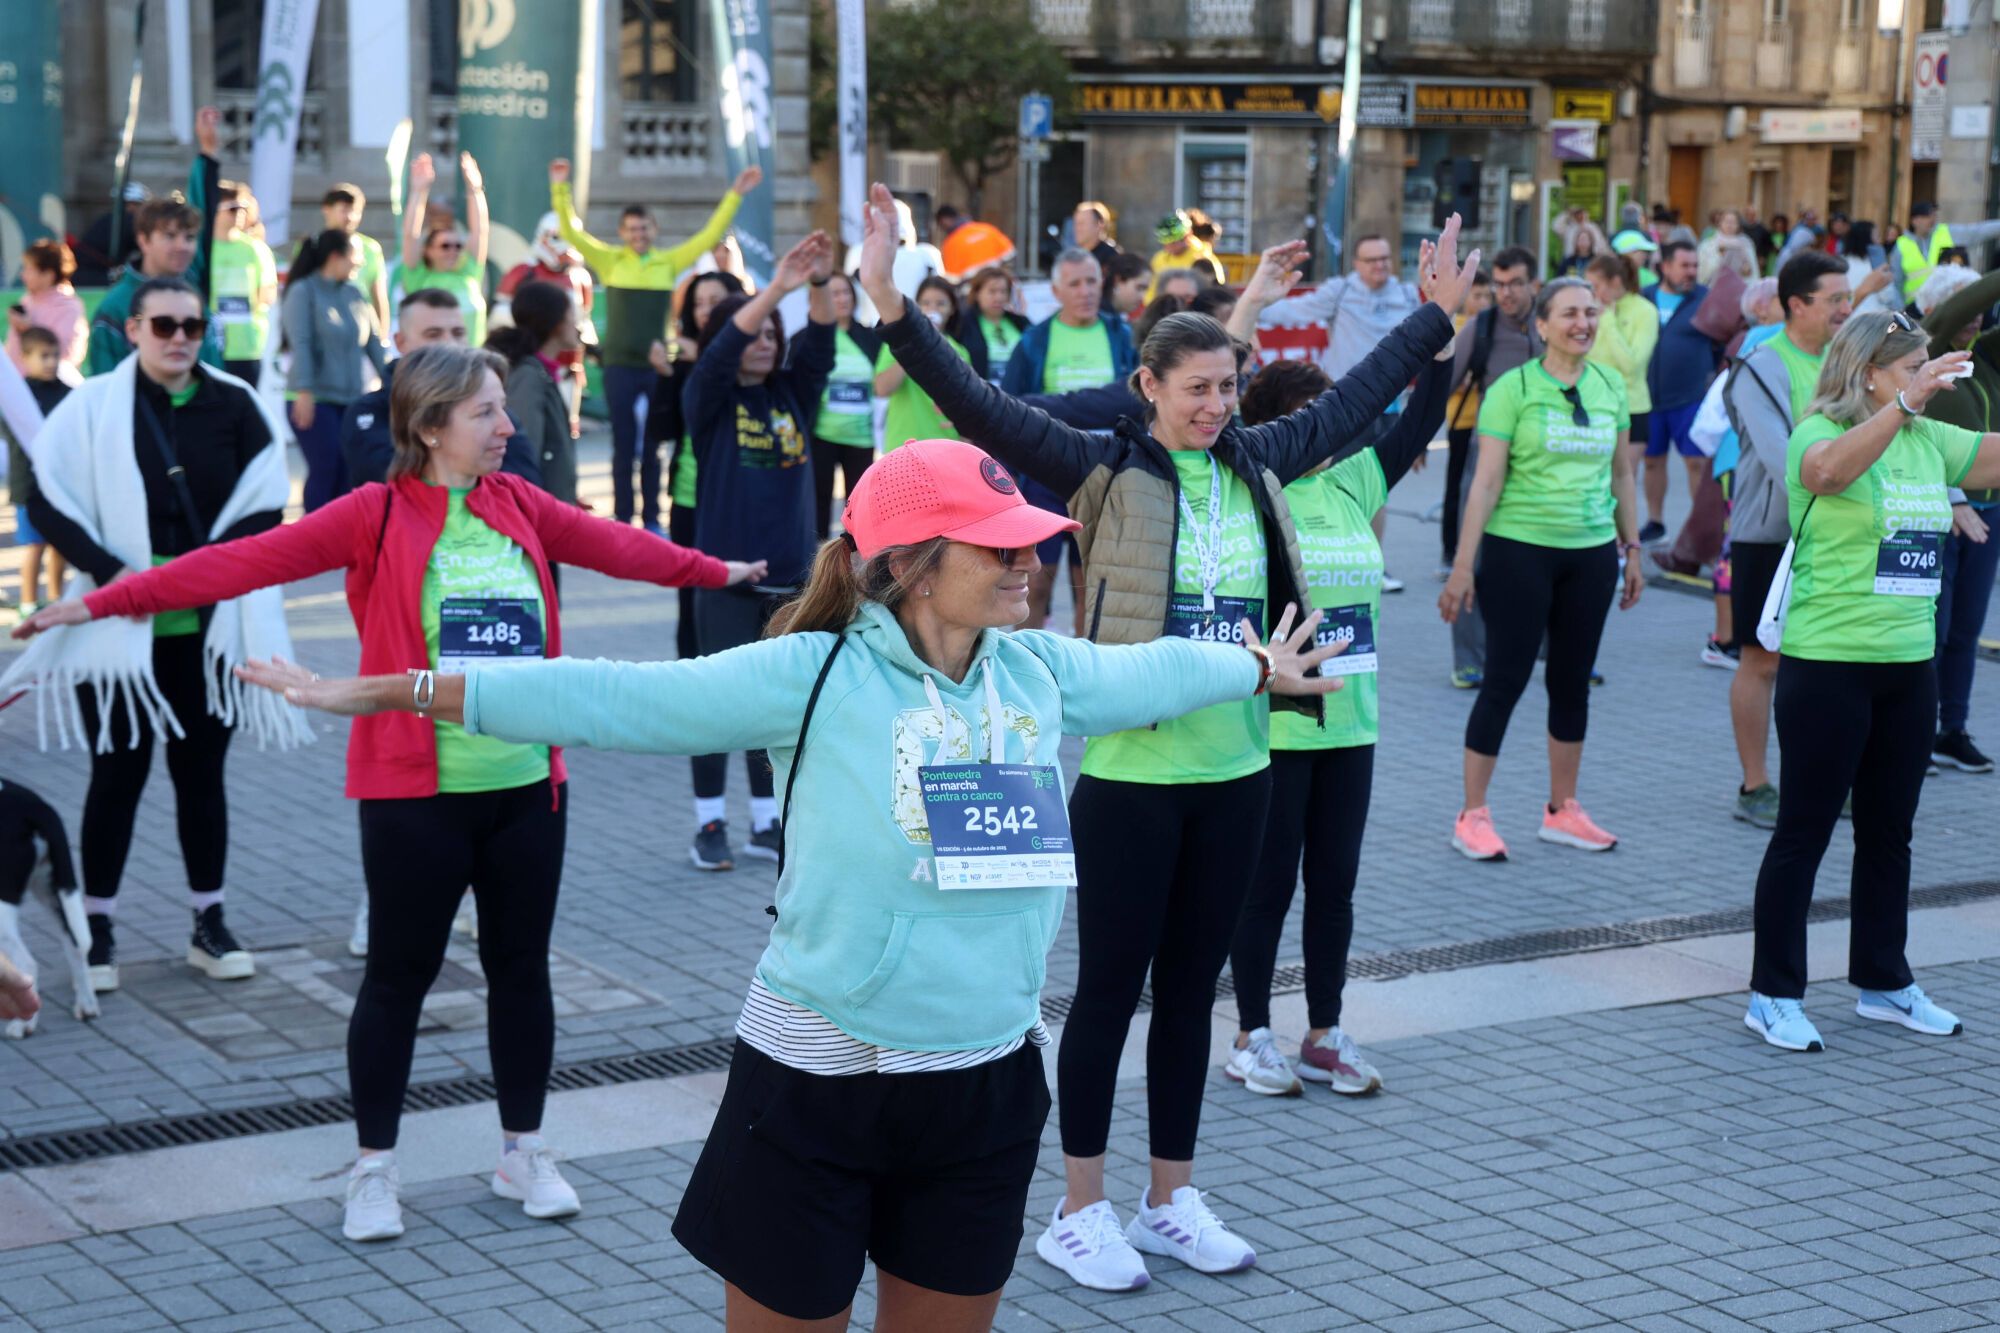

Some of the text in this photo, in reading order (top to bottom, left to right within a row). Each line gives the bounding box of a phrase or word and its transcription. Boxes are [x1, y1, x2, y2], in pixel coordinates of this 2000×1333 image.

[1899, 550, 1937, 569] 0746
[467, 621, 521, 646] 1485
[1189, 621, 1243, 643] 1486
[1318, 625, 1355, 646] 1288
[922, 769, 982, 781] Pontevedra
[925, 780, 979, 792] en marcha
[927, 791, 1003, 802] contra o cancro
[964, 805, 1039, 836] 2542
